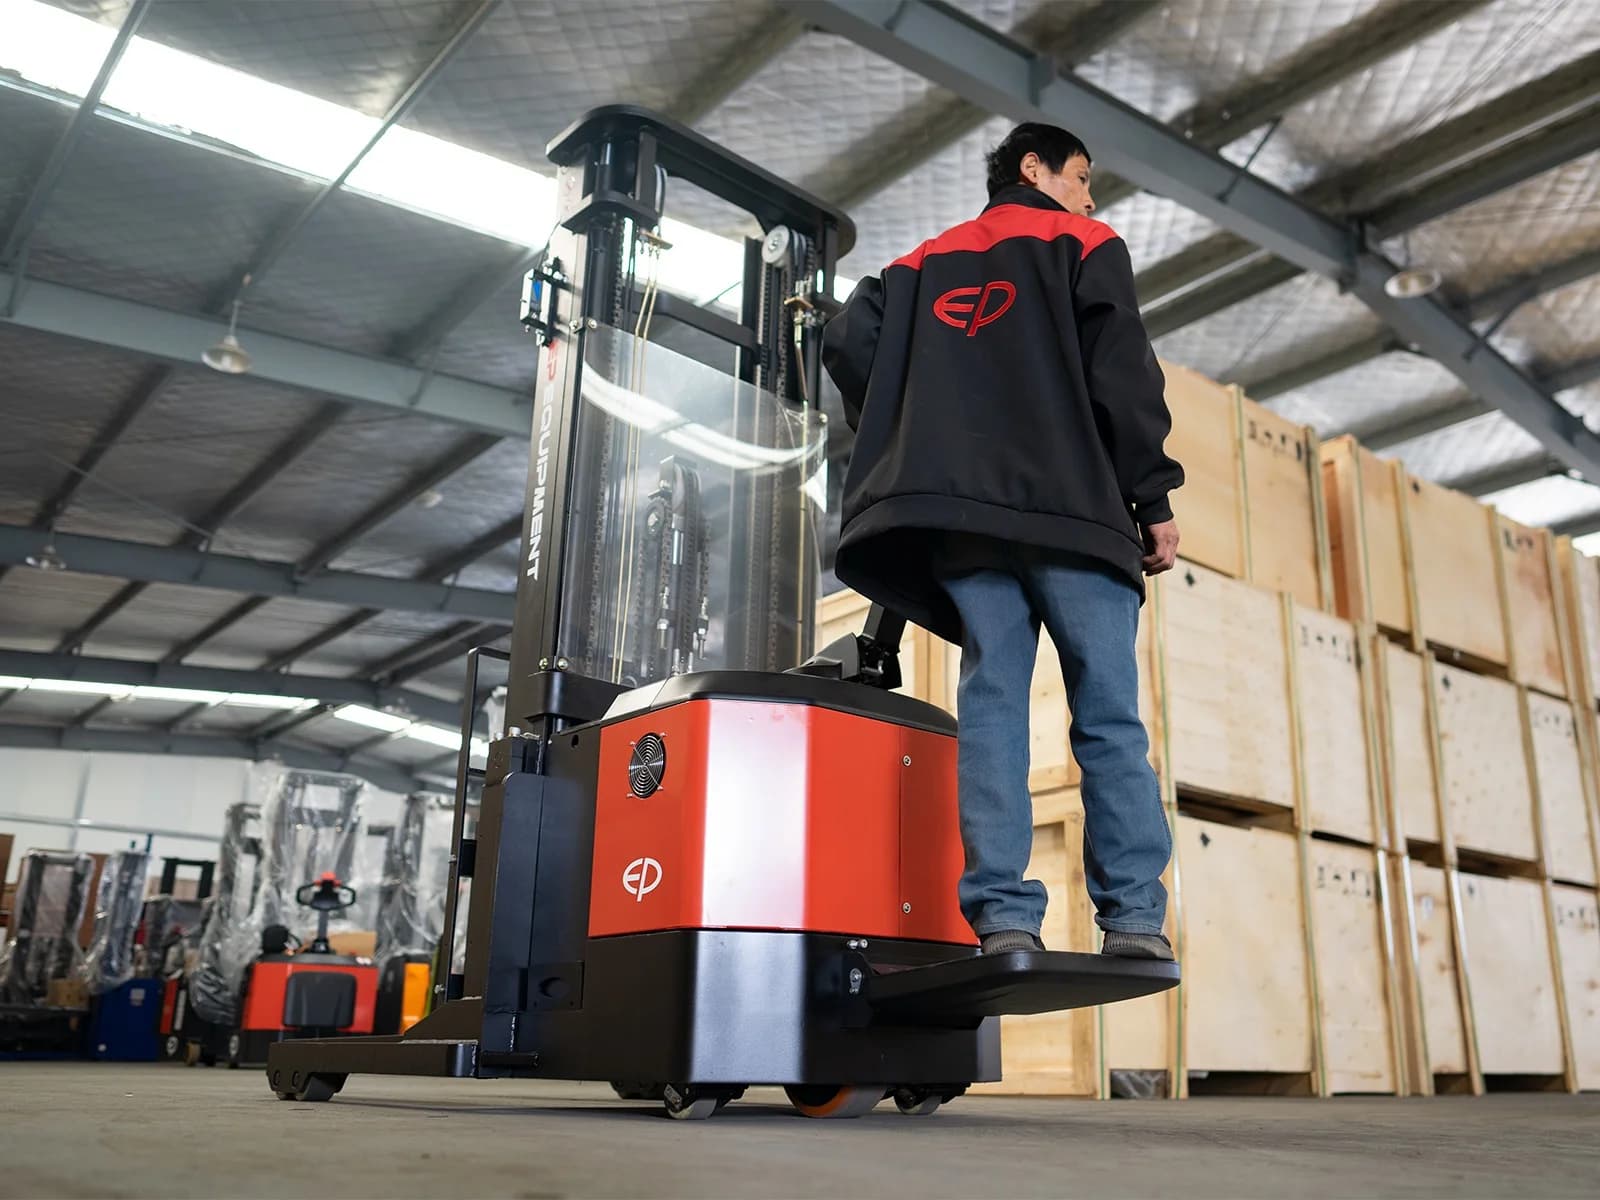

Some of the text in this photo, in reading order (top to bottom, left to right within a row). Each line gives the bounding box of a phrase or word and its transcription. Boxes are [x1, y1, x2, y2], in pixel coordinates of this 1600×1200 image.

[932, 280, 1017, 337] EP
[526, 383, 555, 581] EQUIPMENT
[622, 857, 663, 902] EP
